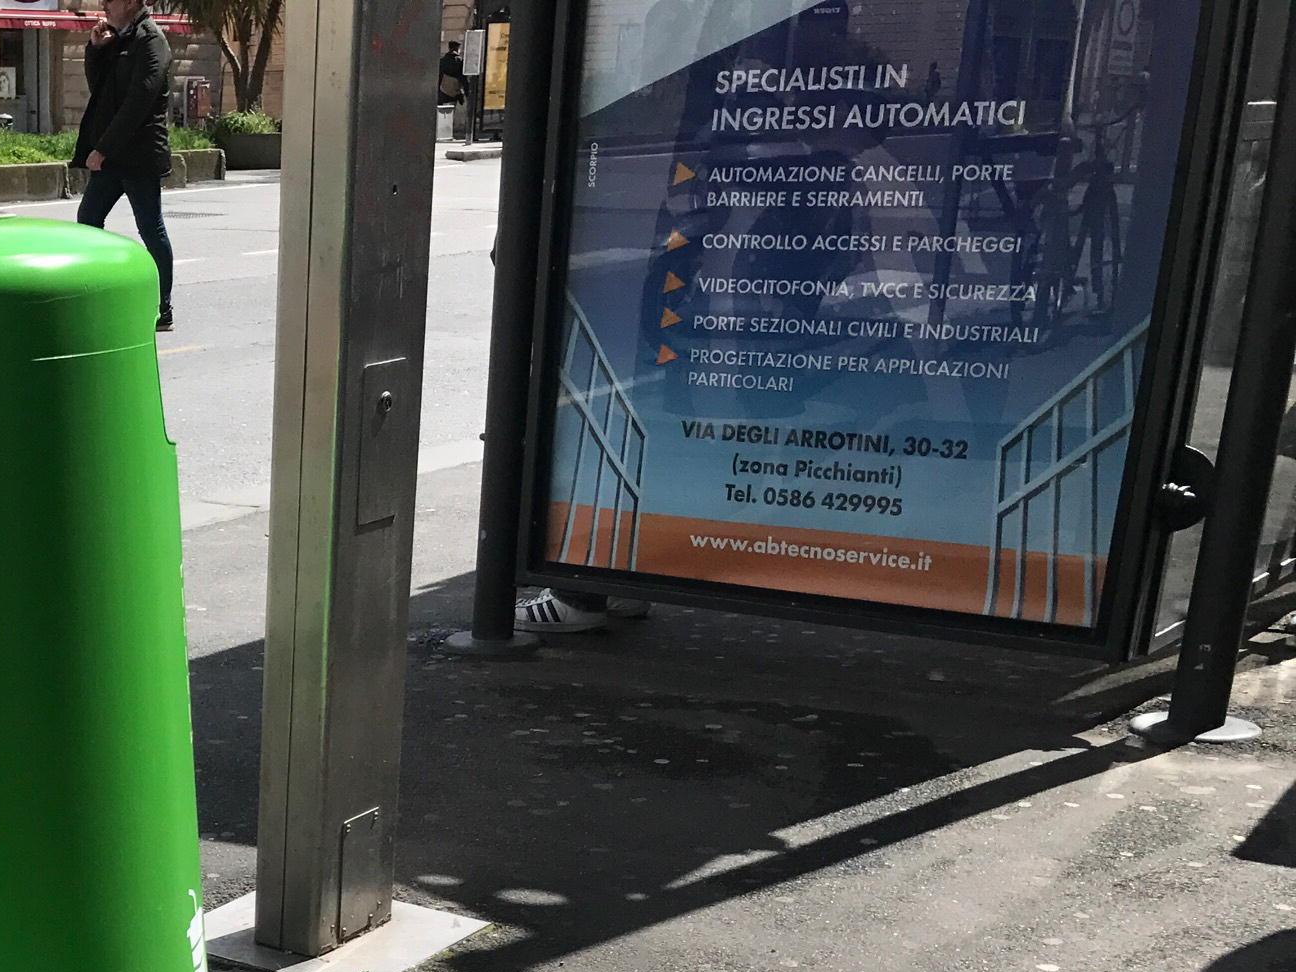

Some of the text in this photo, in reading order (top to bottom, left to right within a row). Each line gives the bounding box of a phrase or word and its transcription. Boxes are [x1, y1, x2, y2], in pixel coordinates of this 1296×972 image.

[715, 64, 908, 94] SPECIALISTI IN
[711, 100, 1026, 131] INGRESSI AUTOMATICI
[588, 142, 599, 188] SCORPIO
[708, 164, 1014, 183] AUTOMAZIONE CANCELLI, PORTE
[706, 190, 924, 207] BARRIERE E SERRAMENTI
[702, 233, 1022, 254] CONTROLLO ACCESSI E PARCHEGGI
[698, 277, 1037, 302] VIDEOCITOFONIA, TVCC E SICUREZZA
[693, 315, 1039, 343] PORTE SEZIONALI CIVILI E INDUSTRIALI
[689, 348, 1010, 379] PROGETTAZIONE PER APPLICAZIONI
[688, 371, 794, 392] PARTICOLARI
[681, 420, 969, 459] VIA DEGLI ARROTINI, 30-32
[732, 452, 902, 488] (zona Picchianti)
[725, 484, 904, 517] Tel. 0586 429995
[690, 533, 933, 572] www.abtecnoservice.it
